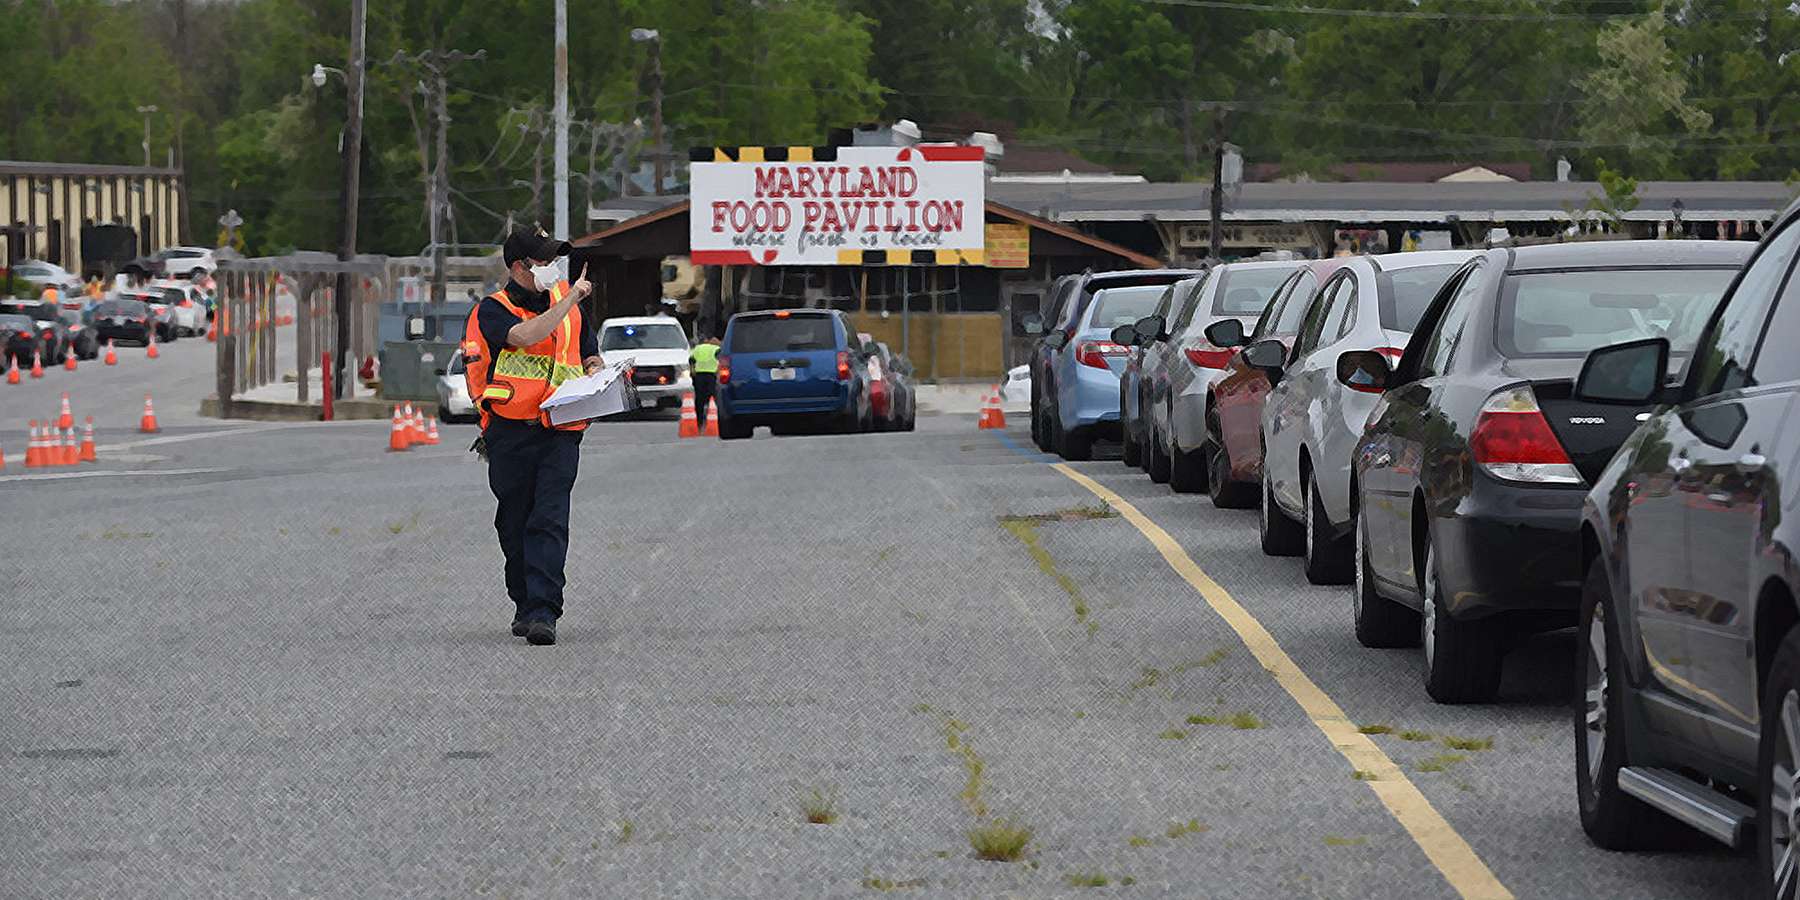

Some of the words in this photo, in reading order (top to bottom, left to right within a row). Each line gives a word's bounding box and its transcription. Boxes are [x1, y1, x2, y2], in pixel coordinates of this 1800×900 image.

[755, 166, 918, 198] MARYLAND
[711, 200, 791, 233] FOOD
[802, 200, 964, 233] PAVILION
[732, 224, 785, 246] where
[798, 224, 848, 254] fresh
[859, 233, 878, 246] is
[891, 221, 944, 246] local
